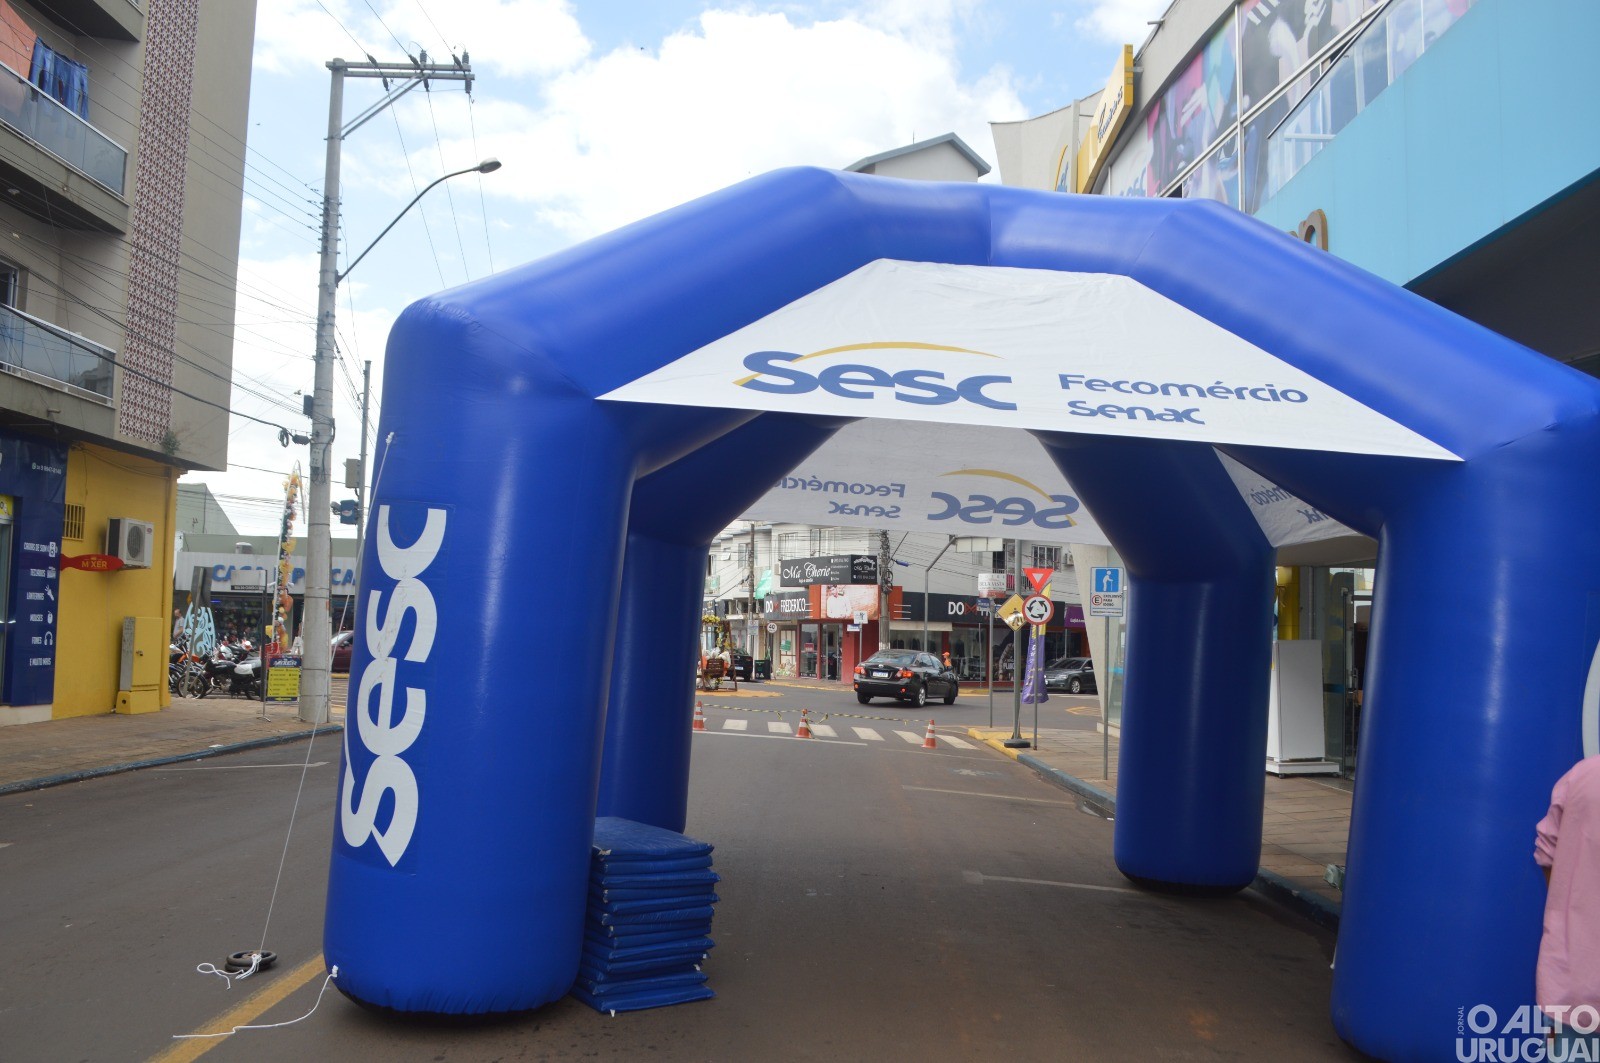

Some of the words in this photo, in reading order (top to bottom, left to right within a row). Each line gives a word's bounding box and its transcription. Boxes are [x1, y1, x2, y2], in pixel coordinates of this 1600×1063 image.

[1058, 373, 1308, 404] Fecomércio
[1067, 400, 1205, 425] Senac
[783, 566, 801, 579] Ma
